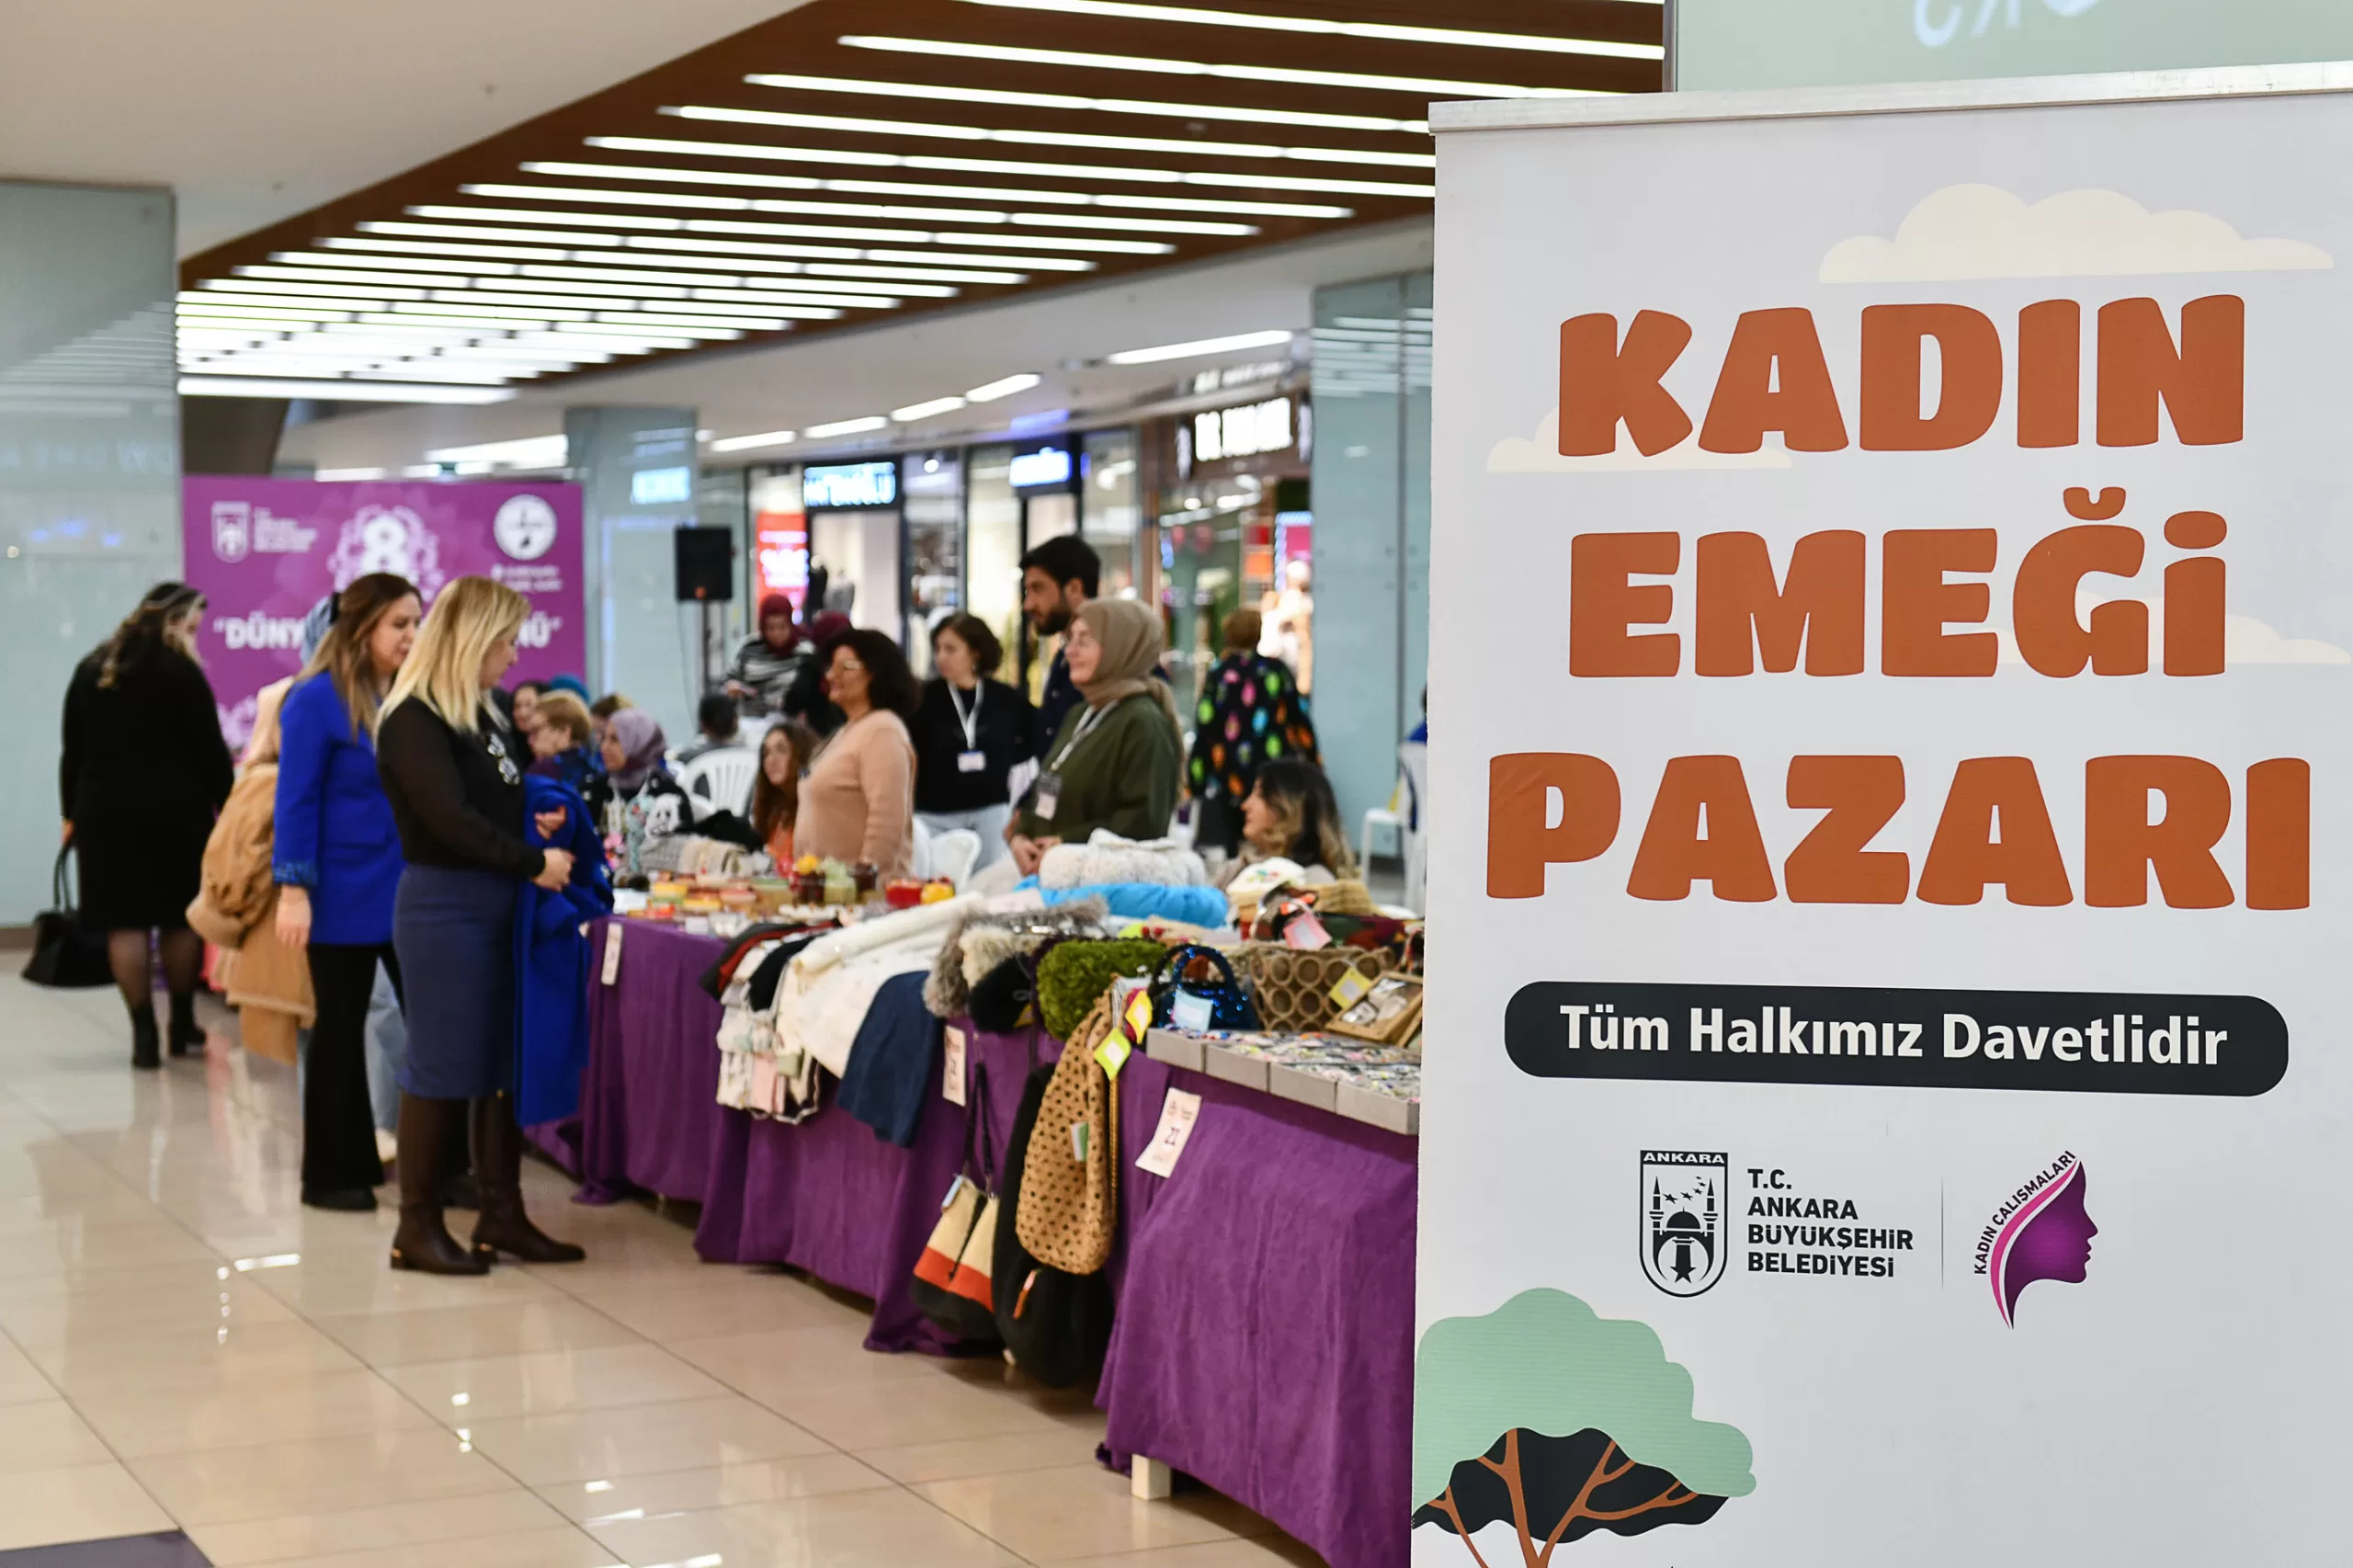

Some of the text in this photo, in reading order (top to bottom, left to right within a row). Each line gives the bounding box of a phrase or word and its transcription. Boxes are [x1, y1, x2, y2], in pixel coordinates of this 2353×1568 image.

[1559, 295, 2244, 457] KADIN
[1570, 487, 2227, 678] EMEĞİ
[1487, 753, 2310, 910] PAZARI
[1561, 1005, 2228, 1066] Tüm Halkımız Davetlidir
[1643, 1152, 1725, 1164] ANKARA
[1747, 1168, 1792, 1190] T.C.
[1747, 1196, 1859, 1221] ANKARA
[1973, 1150, 2076, 1275] KADIN ÇALIŞMALARI
[1747, 1223, 1914, 1251] BÜYÜKŞEHİR
[1747, 1251, 1894, 1278] BELEDİYESİ
